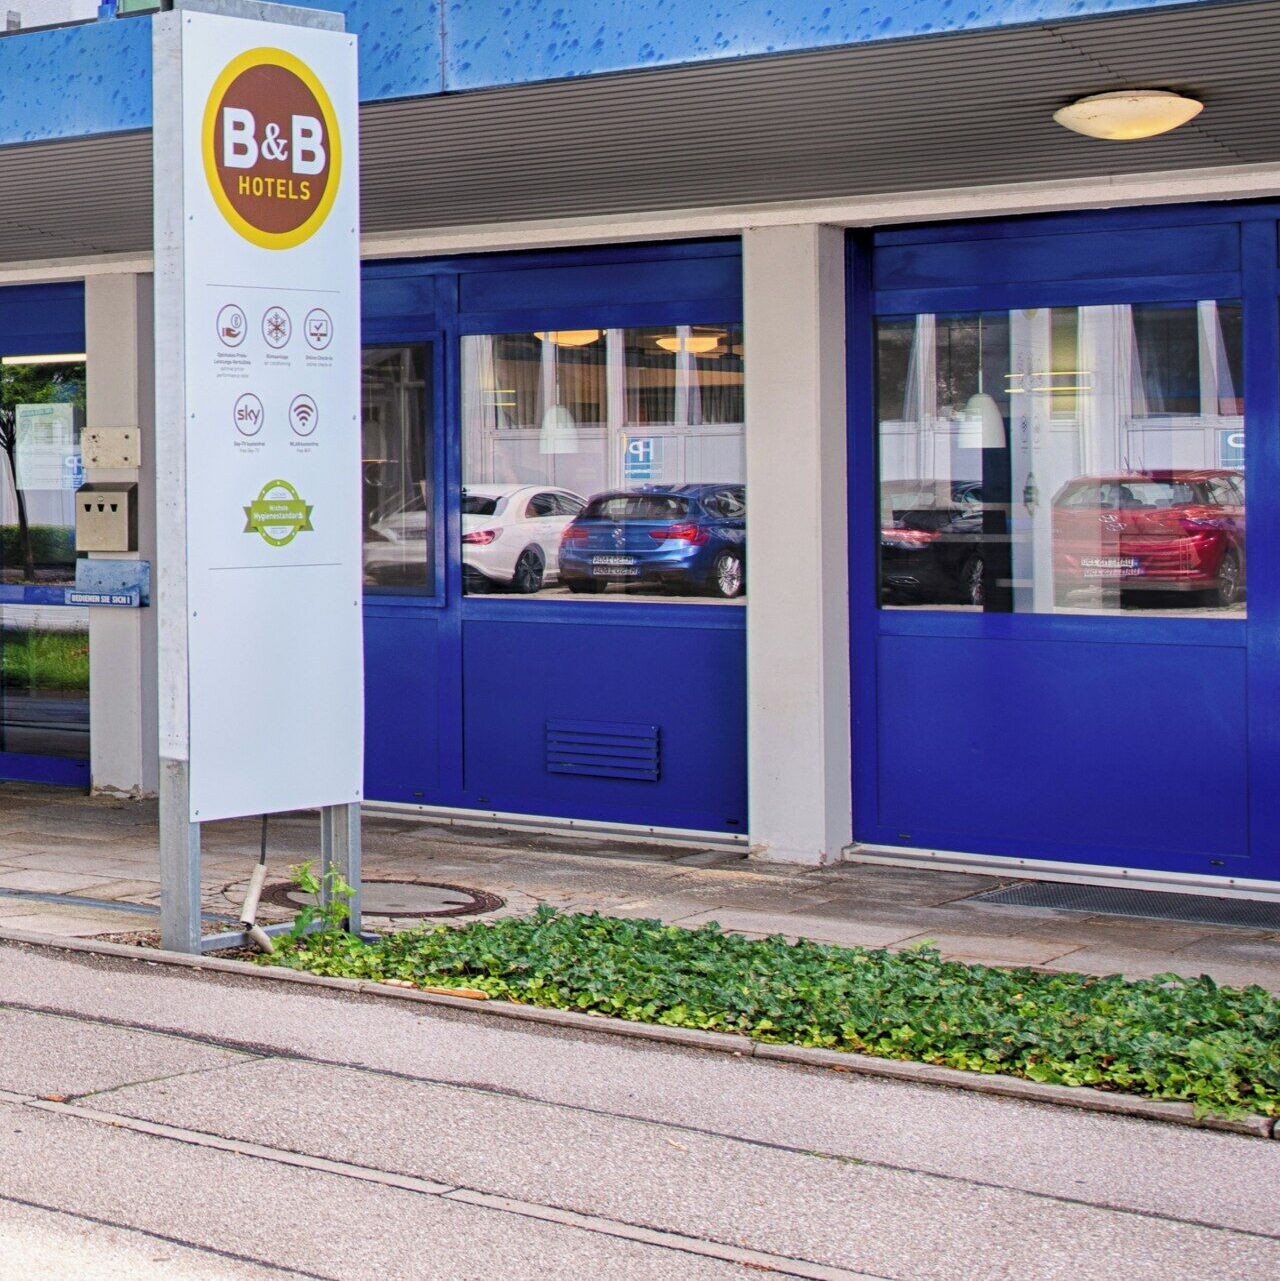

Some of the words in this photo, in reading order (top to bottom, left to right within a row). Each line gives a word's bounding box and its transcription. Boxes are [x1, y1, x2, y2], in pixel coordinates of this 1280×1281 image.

[223, 106, 327, 175] B&B
[238, 175, 311, 201] HOTELS
[237, 404, 260, 425] sky
[101, 595, 111, 604] SIE
